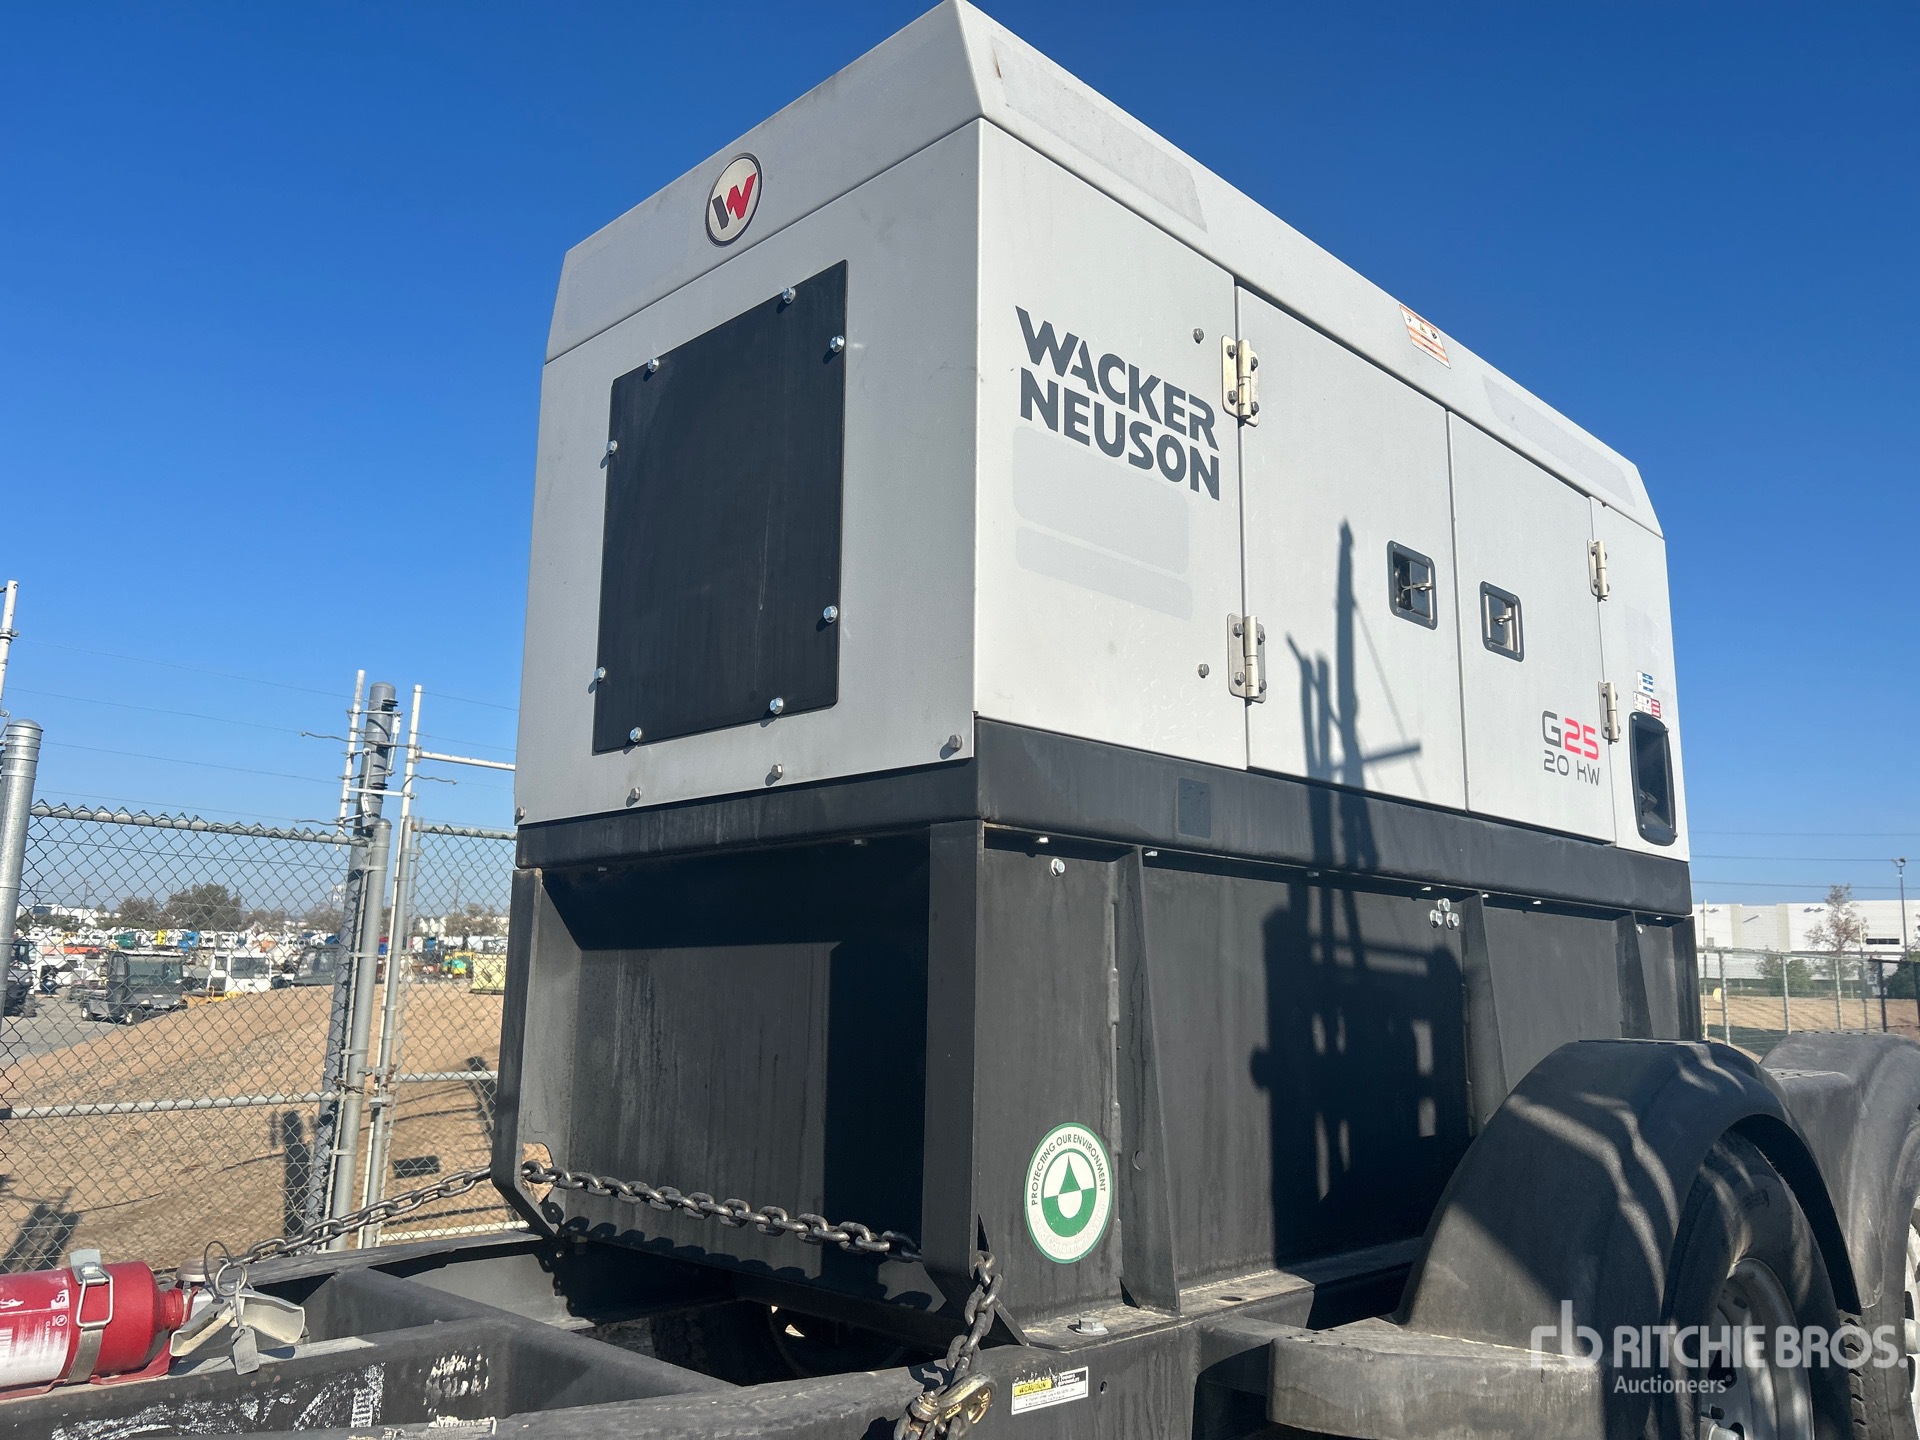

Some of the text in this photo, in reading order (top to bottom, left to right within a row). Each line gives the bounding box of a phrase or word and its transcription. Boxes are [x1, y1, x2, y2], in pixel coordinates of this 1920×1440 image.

[1015, 305, 1219, 451] WACKER
[1020, 366, 1220, 501] NEUSON
[1542, 710, 1599, 761] G25
[1543, 749, 1570, 776] 20
[1031, 1133, 1106, 1206] PROTECTING OUR ENVIRONMENT
